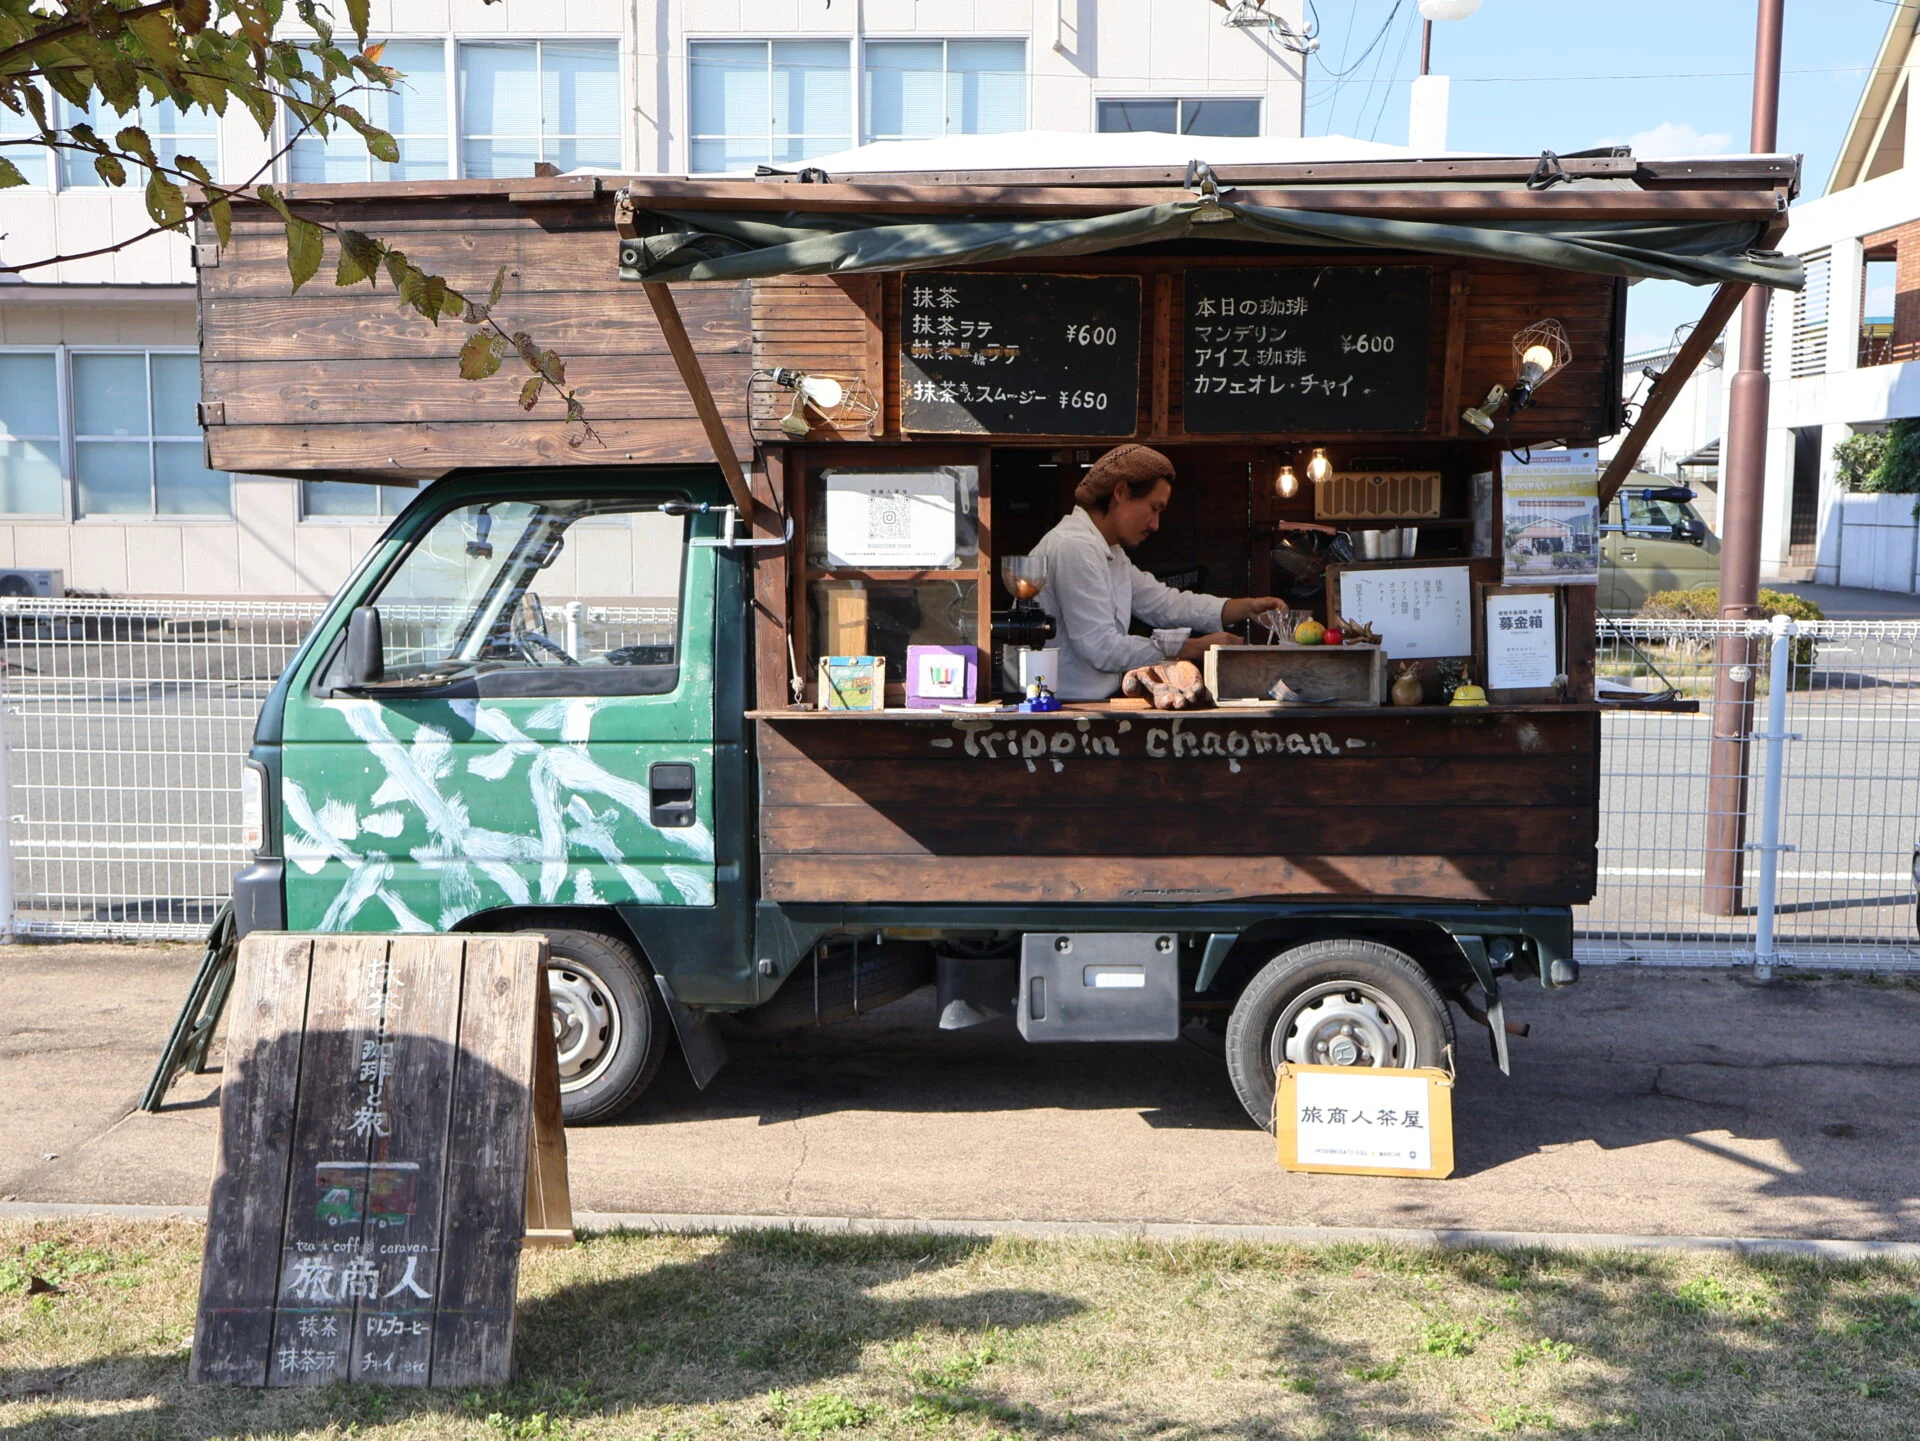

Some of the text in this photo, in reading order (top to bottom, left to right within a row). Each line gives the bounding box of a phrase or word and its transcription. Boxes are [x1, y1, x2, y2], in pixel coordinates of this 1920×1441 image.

[912, 286, 960, 309] 抹茶
[1194, 297, 1309, 318] 本日の珈琲
[912, 314, 993, 339] 抹茶ラテ
[1066, 324, 1117, 346] ¥600
[1194, 325, 1288, 344] マンデリン
[1194, 347, 1308, 368] アイス珈琲
[1059, 390, 1108, 410] ¥650
[1499, 615, 1543, 630] 募金箱
[1301, 1106, 1425, 1129] 旅商人茶屋
[380, 1243, 428, 1255] caravan
[288, 1255, 434, 1300] 旅商人
[299, 1316, 338, 1338] 抹茶
